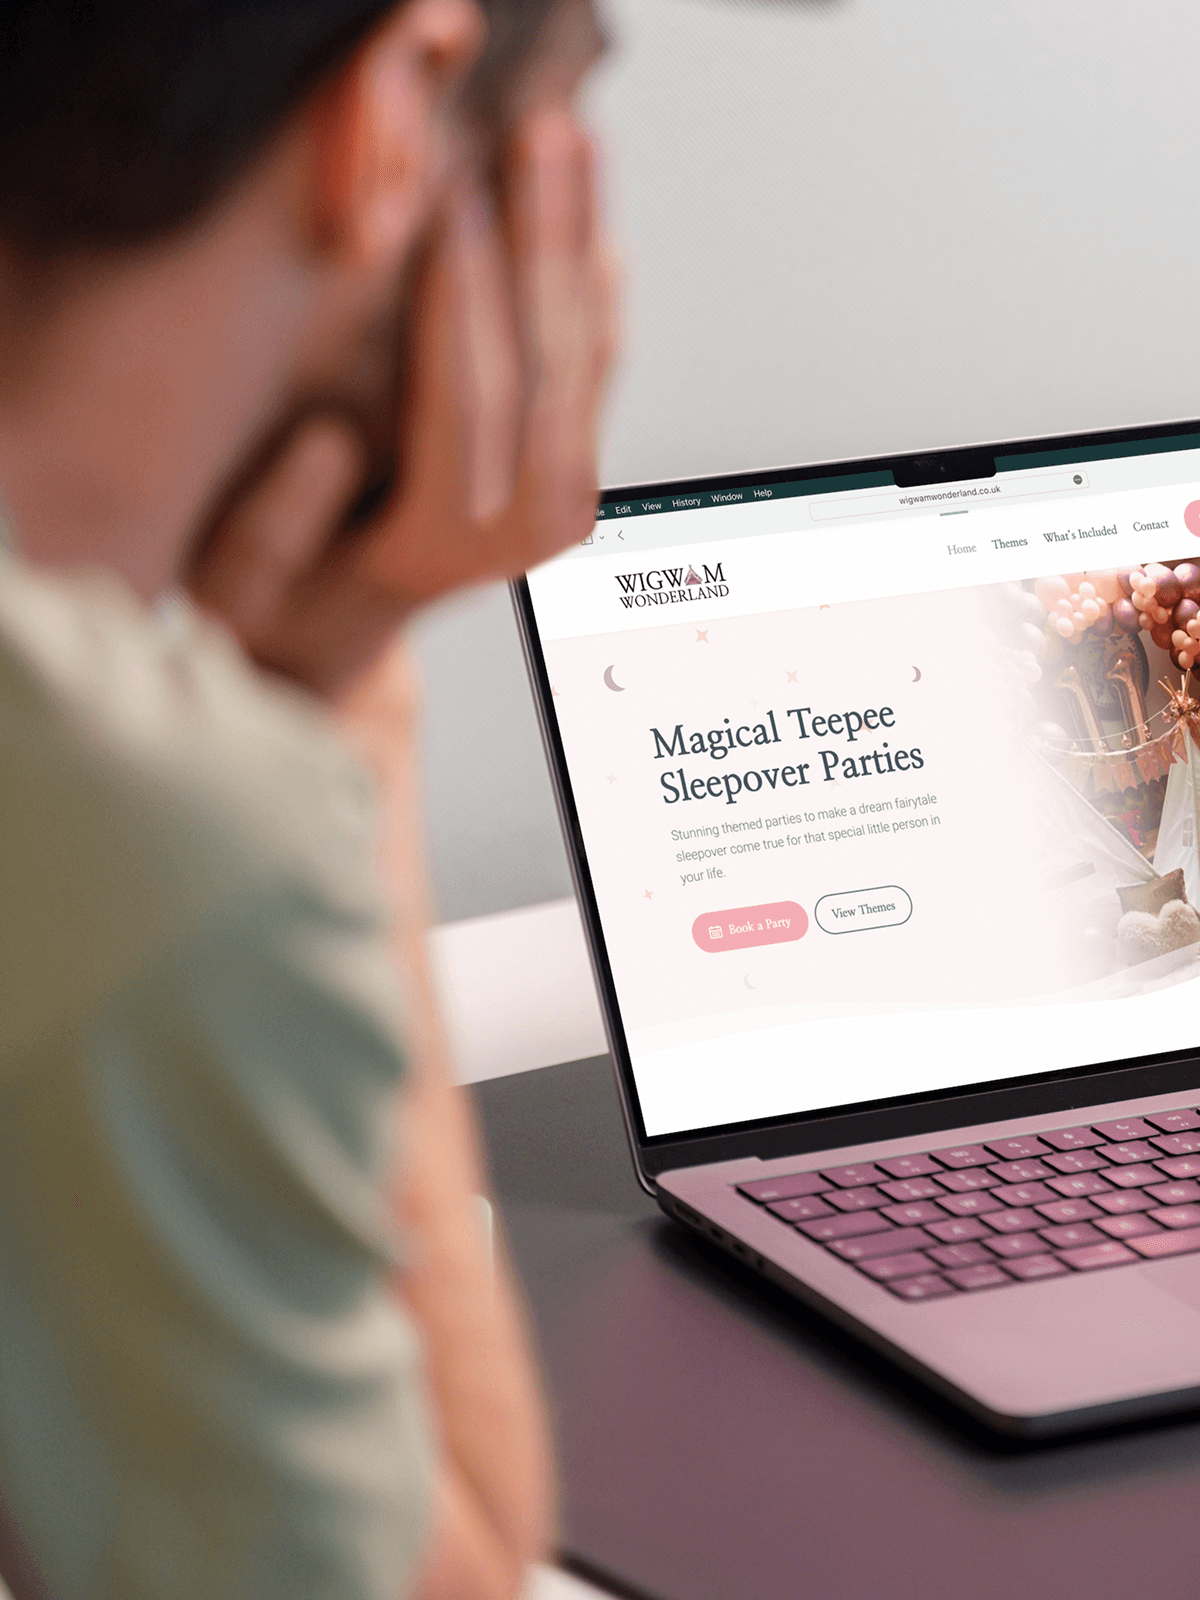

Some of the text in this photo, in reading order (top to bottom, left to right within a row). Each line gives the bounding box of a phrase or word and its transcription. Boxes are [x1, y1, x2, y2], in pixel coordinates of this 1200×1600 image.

[595, 488, 773, 517] ile Edit View History Window Help
[899, 484, 1001, 505] wigwamwonderland.co.uk
[946, 542, 977, 556] Home
[991, 536, 1029, 551] Themes
[1077, 524, 1119, 542] Included
[1132, 518, 1170, 534] Contact
[619, 584, 730, 609] WONDERLAND
[649, 705, 896, 760] Magical Teepee
[659, 741, 925, 805] Sleepover Parties
[670, 793, 937, 842] Stunning themed parties to make a dream fairytale
[675, 814, 941, 863] sleepover come true for that special little person in
[679, 866, 727, 887] your life.
[831, 900, 896, 920] View Themes
[728, 915, 792, 936] Book a Party
